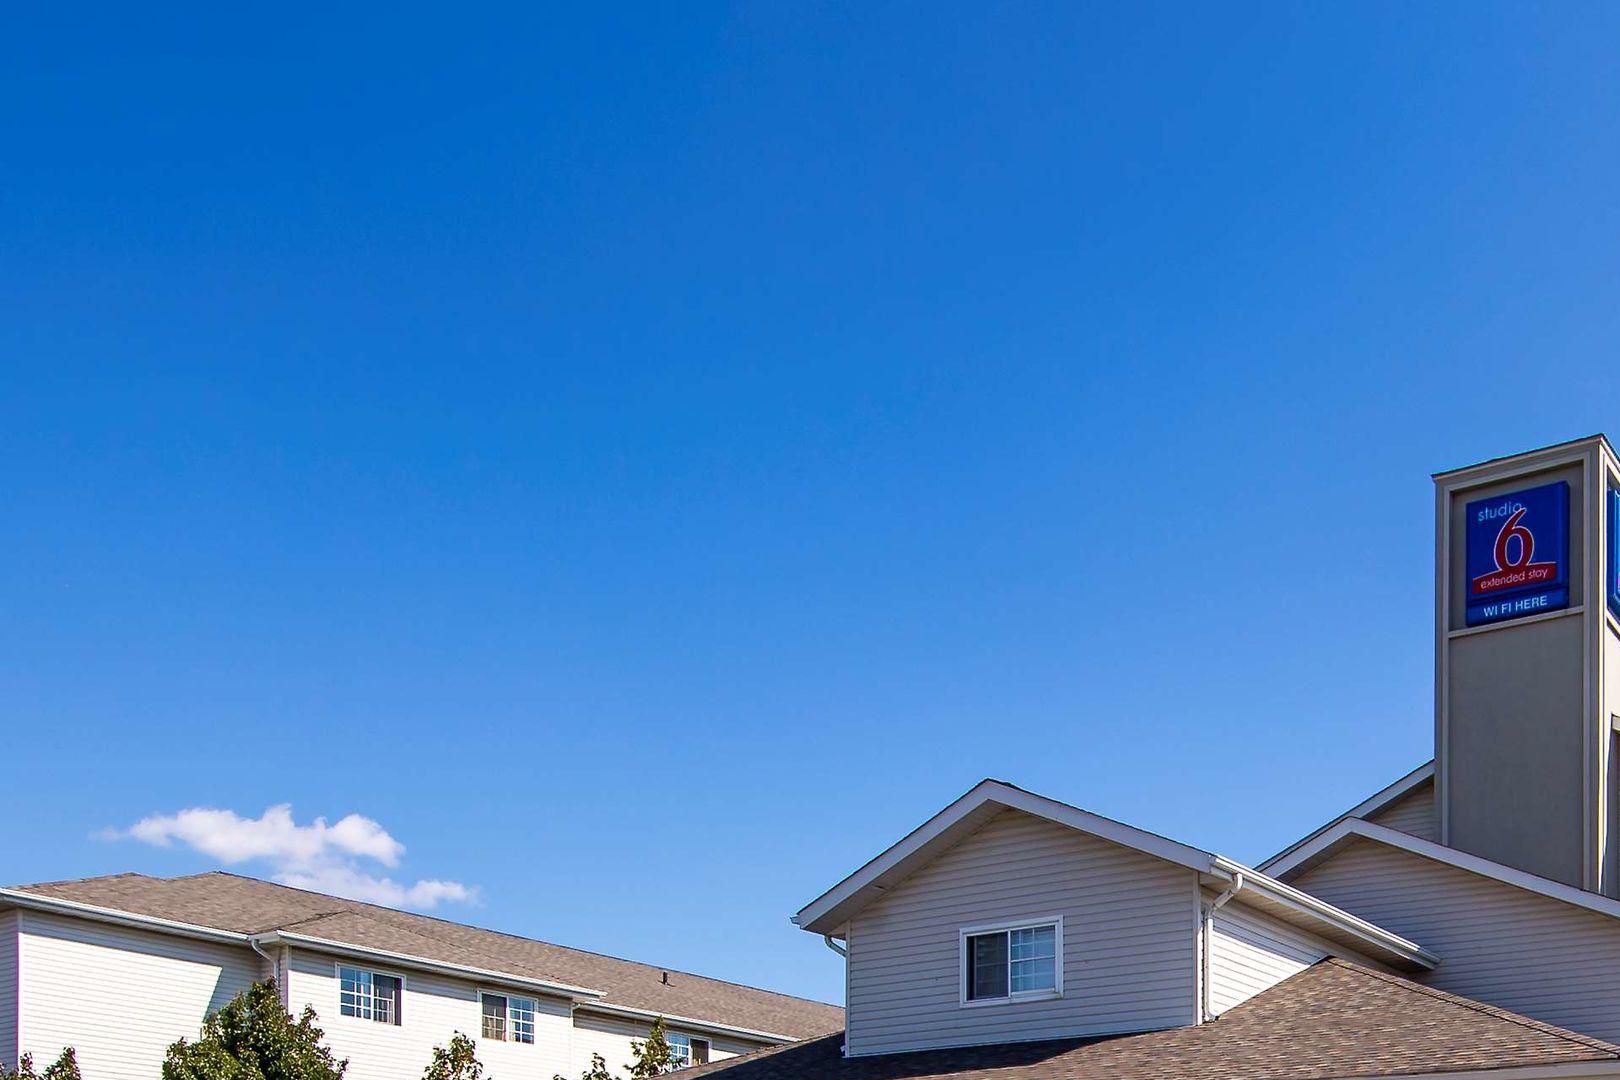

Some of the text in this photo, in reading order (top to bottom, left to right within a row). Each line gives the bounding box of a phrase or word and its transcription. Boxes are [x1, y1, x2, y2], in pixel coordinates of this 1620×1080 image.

[1478, 501, 1522, 522] studio
[1493, 507, 1535, 572] 6
[1480, 567, 1548, 590] extended stay
[1483, 595, 1548, 617] WI FI HERE
